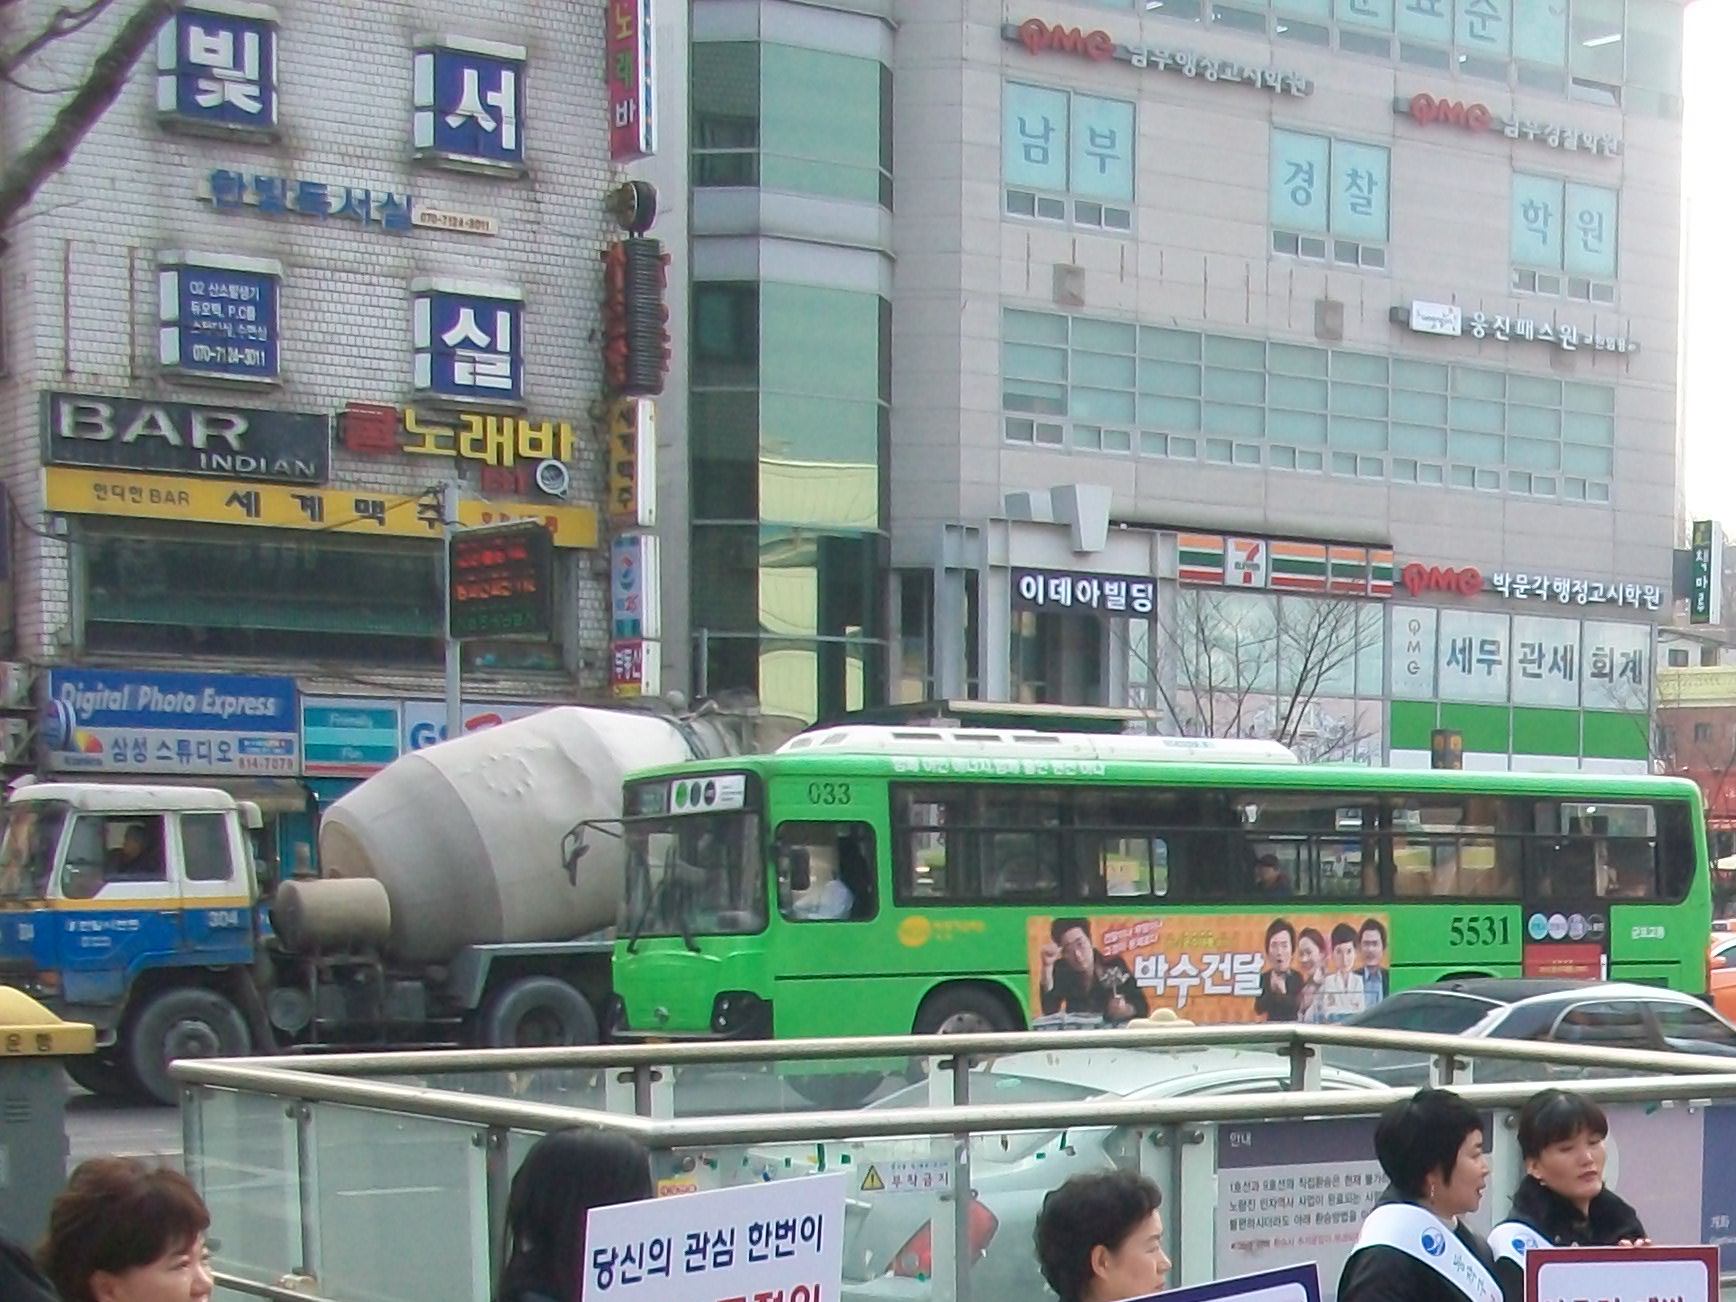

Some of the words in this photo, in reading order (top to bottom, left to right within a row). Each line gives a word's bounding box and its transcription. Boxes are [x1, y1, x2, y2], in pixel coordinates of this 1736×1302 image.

[446, 67, 516, 150] 서
[1016, 115, 1122, 175] 남부
[1282, 160, 1377, 216] 경찰
[1519, 198, 1605, 255] 학원
[442, 306, 514, 390] 실
[59, 399, 249, 452] BAR
[199, 453, 317, 479] INDIAN
[148, 486, 191, 508] BAR
[1018, 574, 1157, 613] 이데아빌딩
[1491, 571, 1661, 611] 박문각행정고시학원
[1445, 636, 1504, 677] 세무
[1516, 639, 1575, 681] 관세
[1590, 644, 1644, 687] 회계
[60, 682, 129, 720] Digital
[137, 684, 196, 714] Photo
[201, 687, 277, 720] Express
[110, 737, 149, 765] 삼성
[155, 738, 235, 767] 스튜디오
[807, 782, 851, 805] 033
[208, 911, 238, 928] 304
[1450, 915, 1510, 947] 5531
[1134, 952, 1266, 1010] 박수건달
[1229, 1131, 1252, 1148] 안내
[592, 1237, 672, 1291] 당신의
[684, 1227, 736, 1274] 관심
[747, 1214, 824, 1263] 한번이
